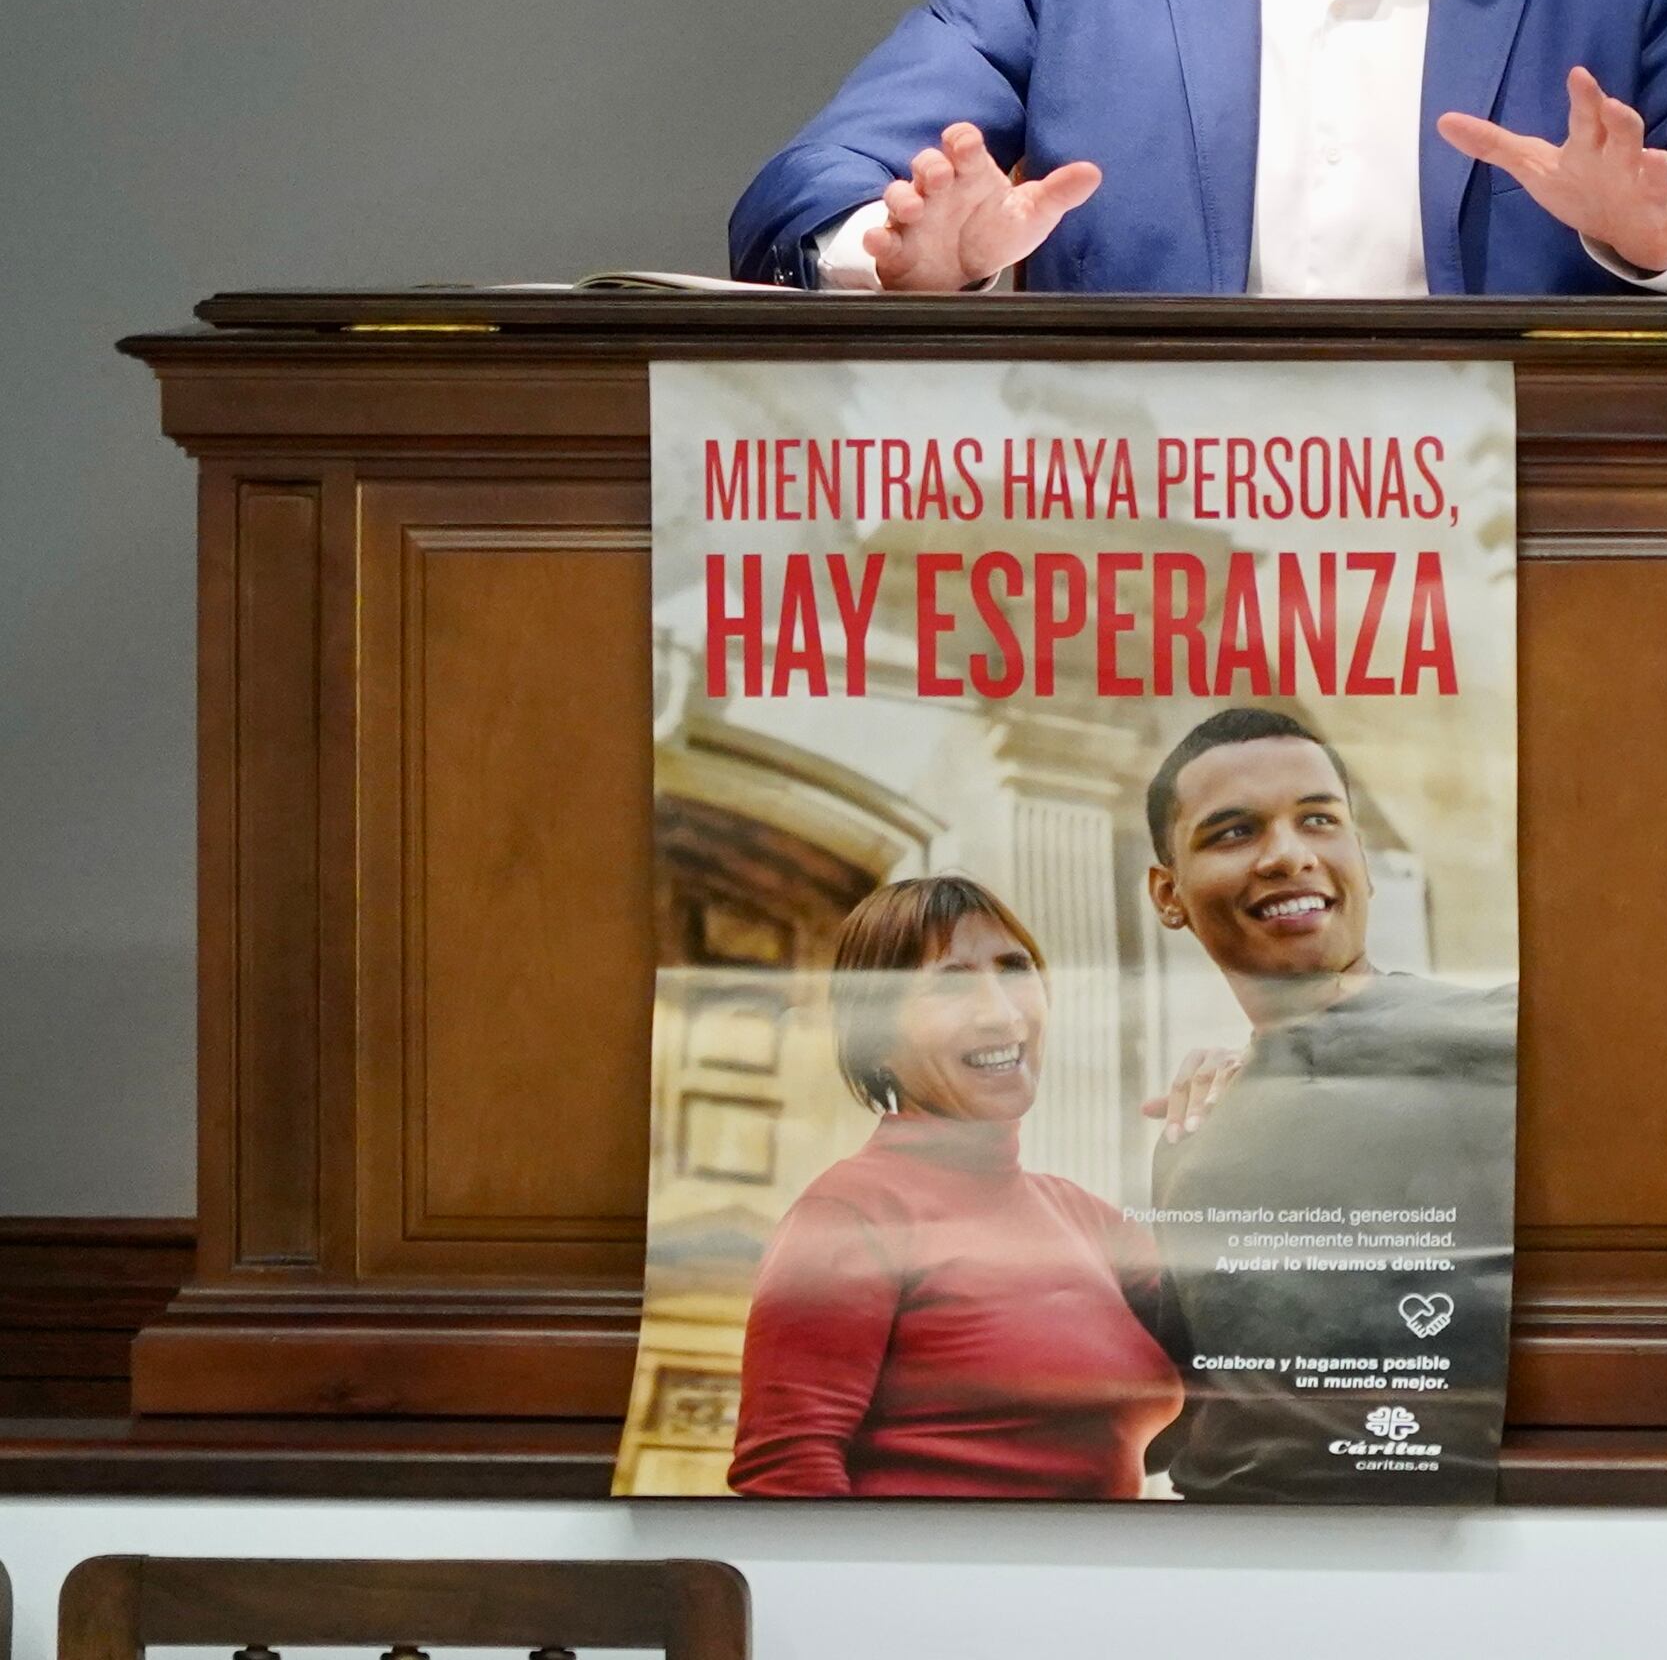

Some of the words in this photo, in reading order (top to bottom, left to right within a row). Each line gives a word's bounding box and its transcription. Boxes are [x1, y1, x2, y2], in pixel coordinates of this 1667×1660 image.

[704, 437, 984, 522] MIENTRAS
[1003, 437, 1141, 520] HAYA
[1157, 434, 1459, 528] PERSONAS,
[705, 551, 887, 699] HAY
[916, 550, 1459, 697] ESPERANZA
[1122, 1207, 1203, 1223] Podemos
[1208, 1207, 1273, 1223] llamarlo
[1278, 1207, 1345, 1225] caridad,
[1350, 1207, 1456, 1226] generosidad
[1228, 1235, 1239, 1248] o
[1243, 1232, 1353, 1251] simplemente
[1358, 1232, 1455, 1248] humanidad.
[1216, 1256, 1279, 1275] Ayudar
[1284, 1256, 1301, 1271] lo
[1307, 1256, 1386, 1271] llevamos
[1391, 1256, 1455, 1271] dentro.
[1192, 1355, 1275, 1370] Colabora
[1280, 1359, 1291, 1374] y
[1295, 1355, 1378, 1374] hagamos
[1383, 1356, 1450, 1374] posible
[1296, 1376, 1319, 1389] un
[1323, 1375, 1387, 1389] mundo
[1391, 1375, 1449, 1392] mejor.
[1329, 1440, 1442, 1456] Cáritas
[1355, 1459, 1439, 1472] caritas.es
